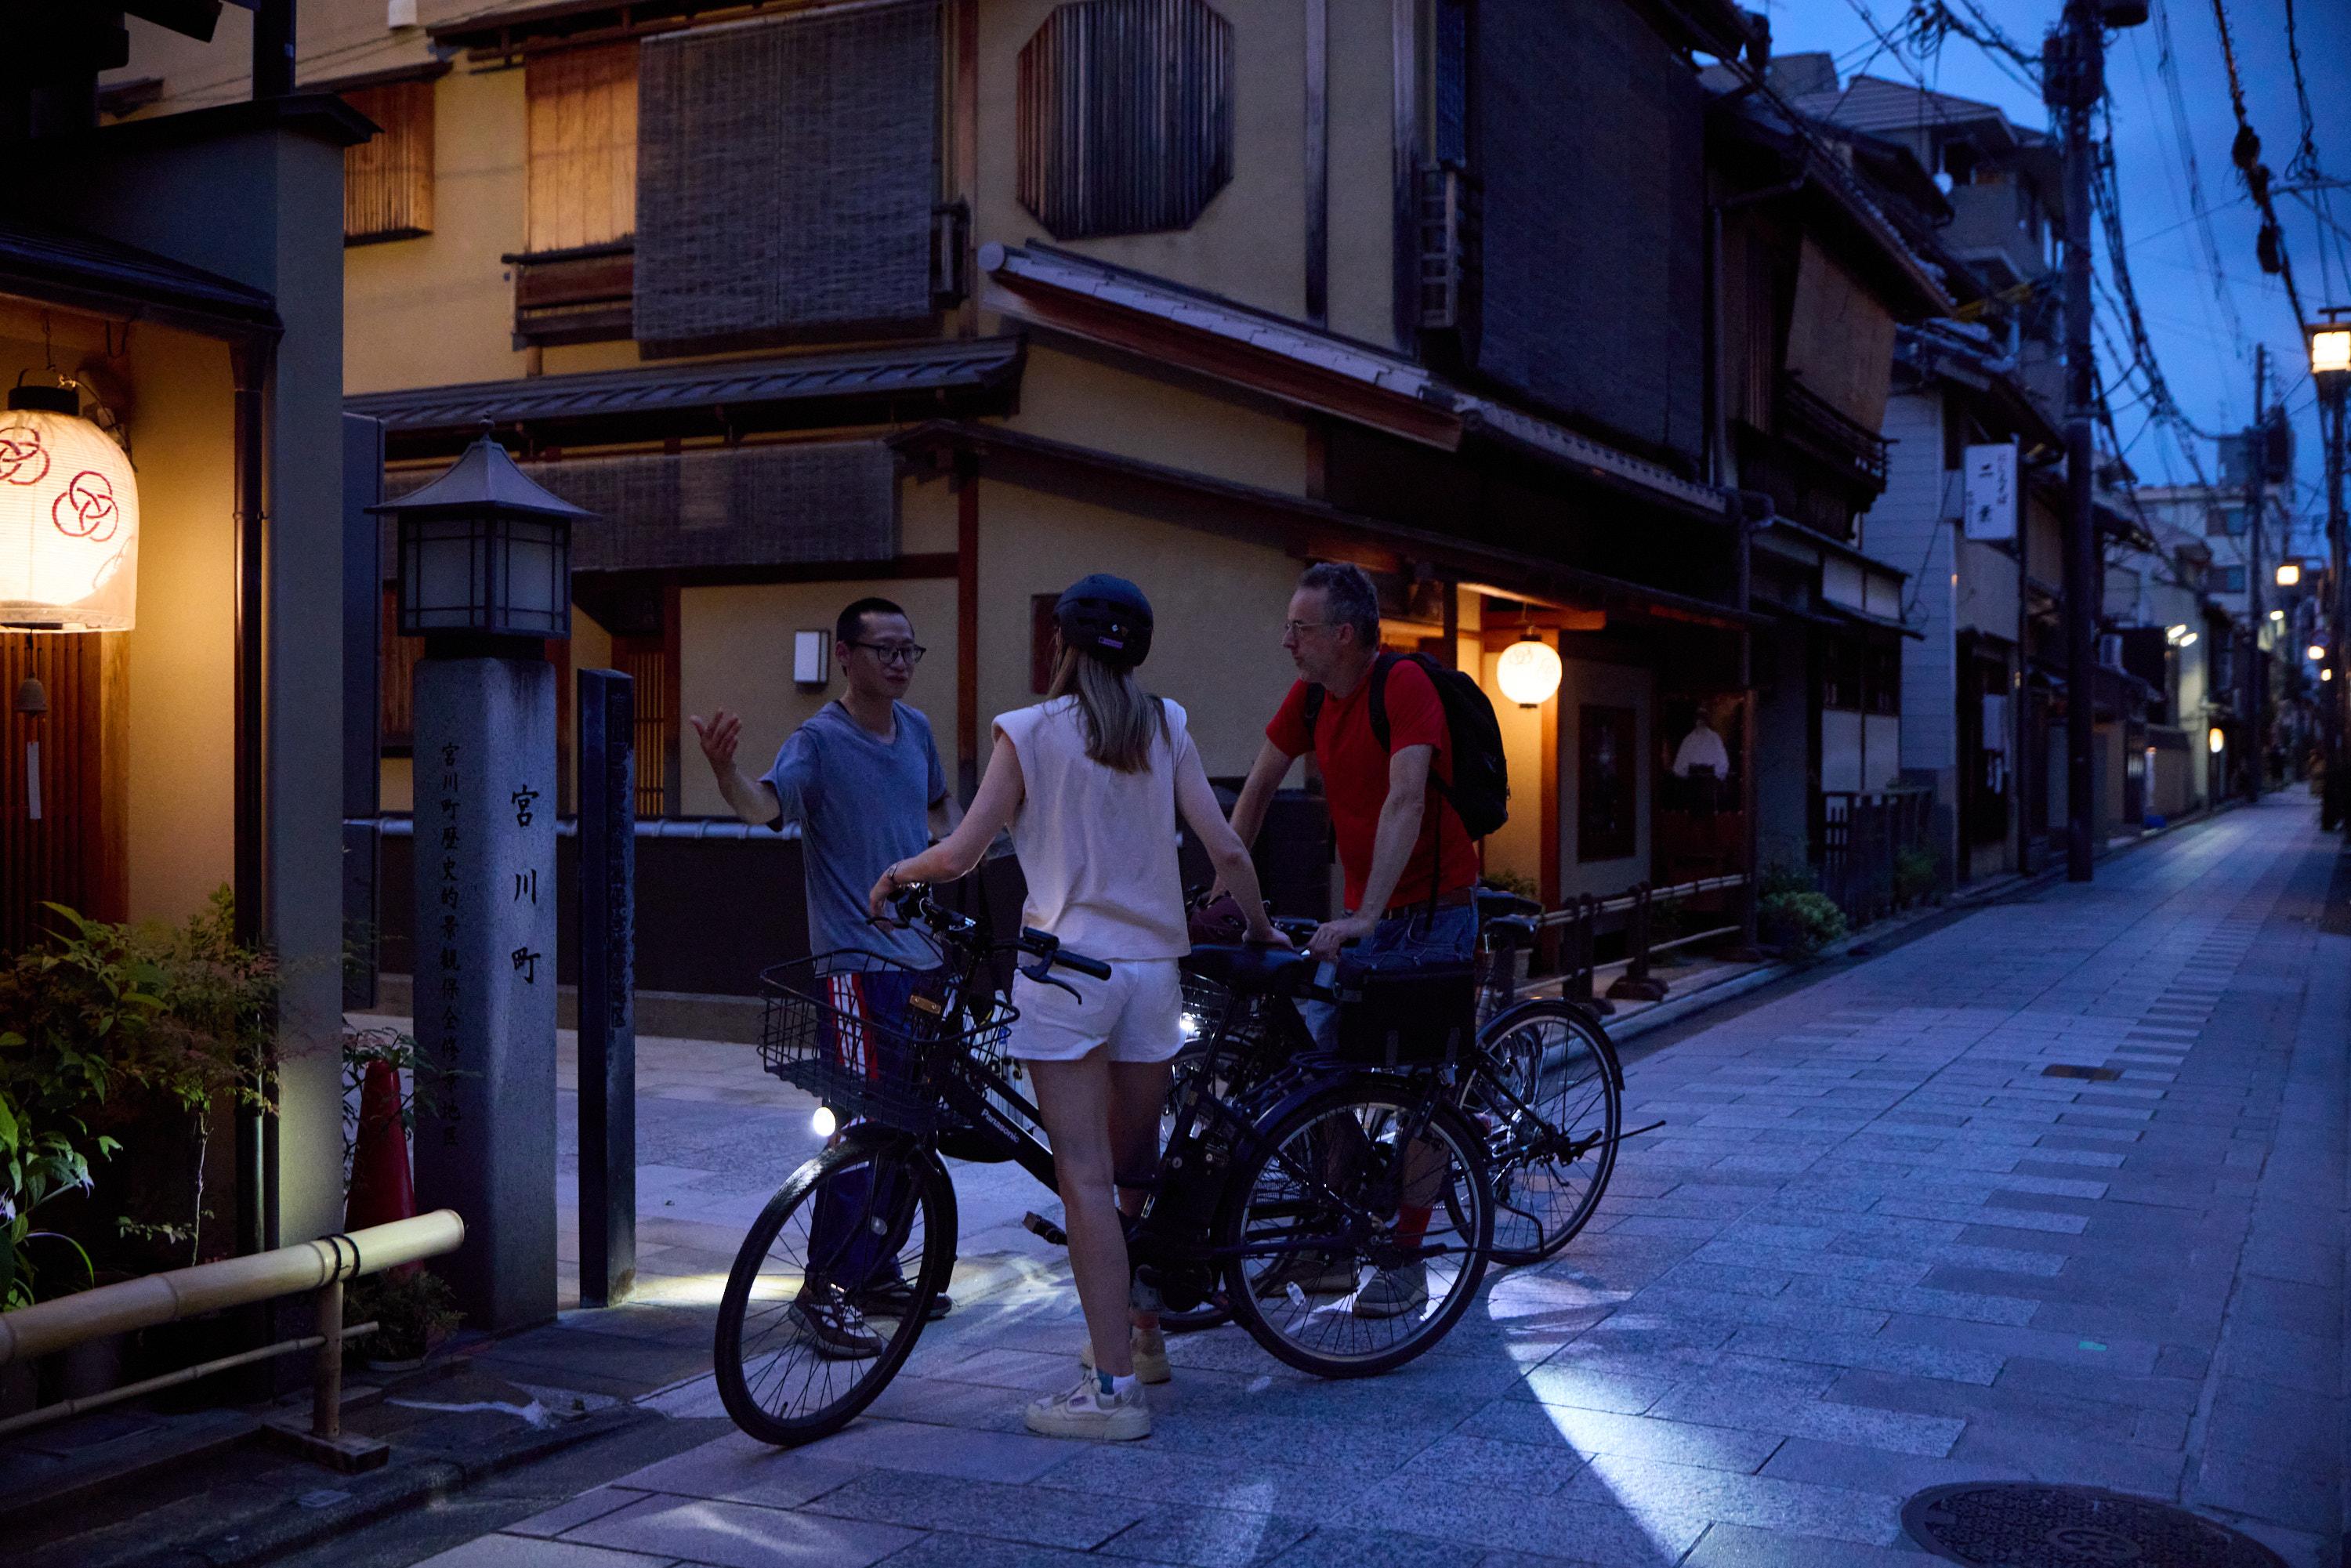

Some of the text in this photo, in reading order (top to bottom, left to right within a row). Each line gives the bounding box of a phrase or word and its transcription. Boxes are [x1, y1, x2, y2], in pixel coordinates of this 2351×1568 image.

[512, 784, 541, 984] 宮川町
[980, 1107, 1020, 1144] Panasonic
